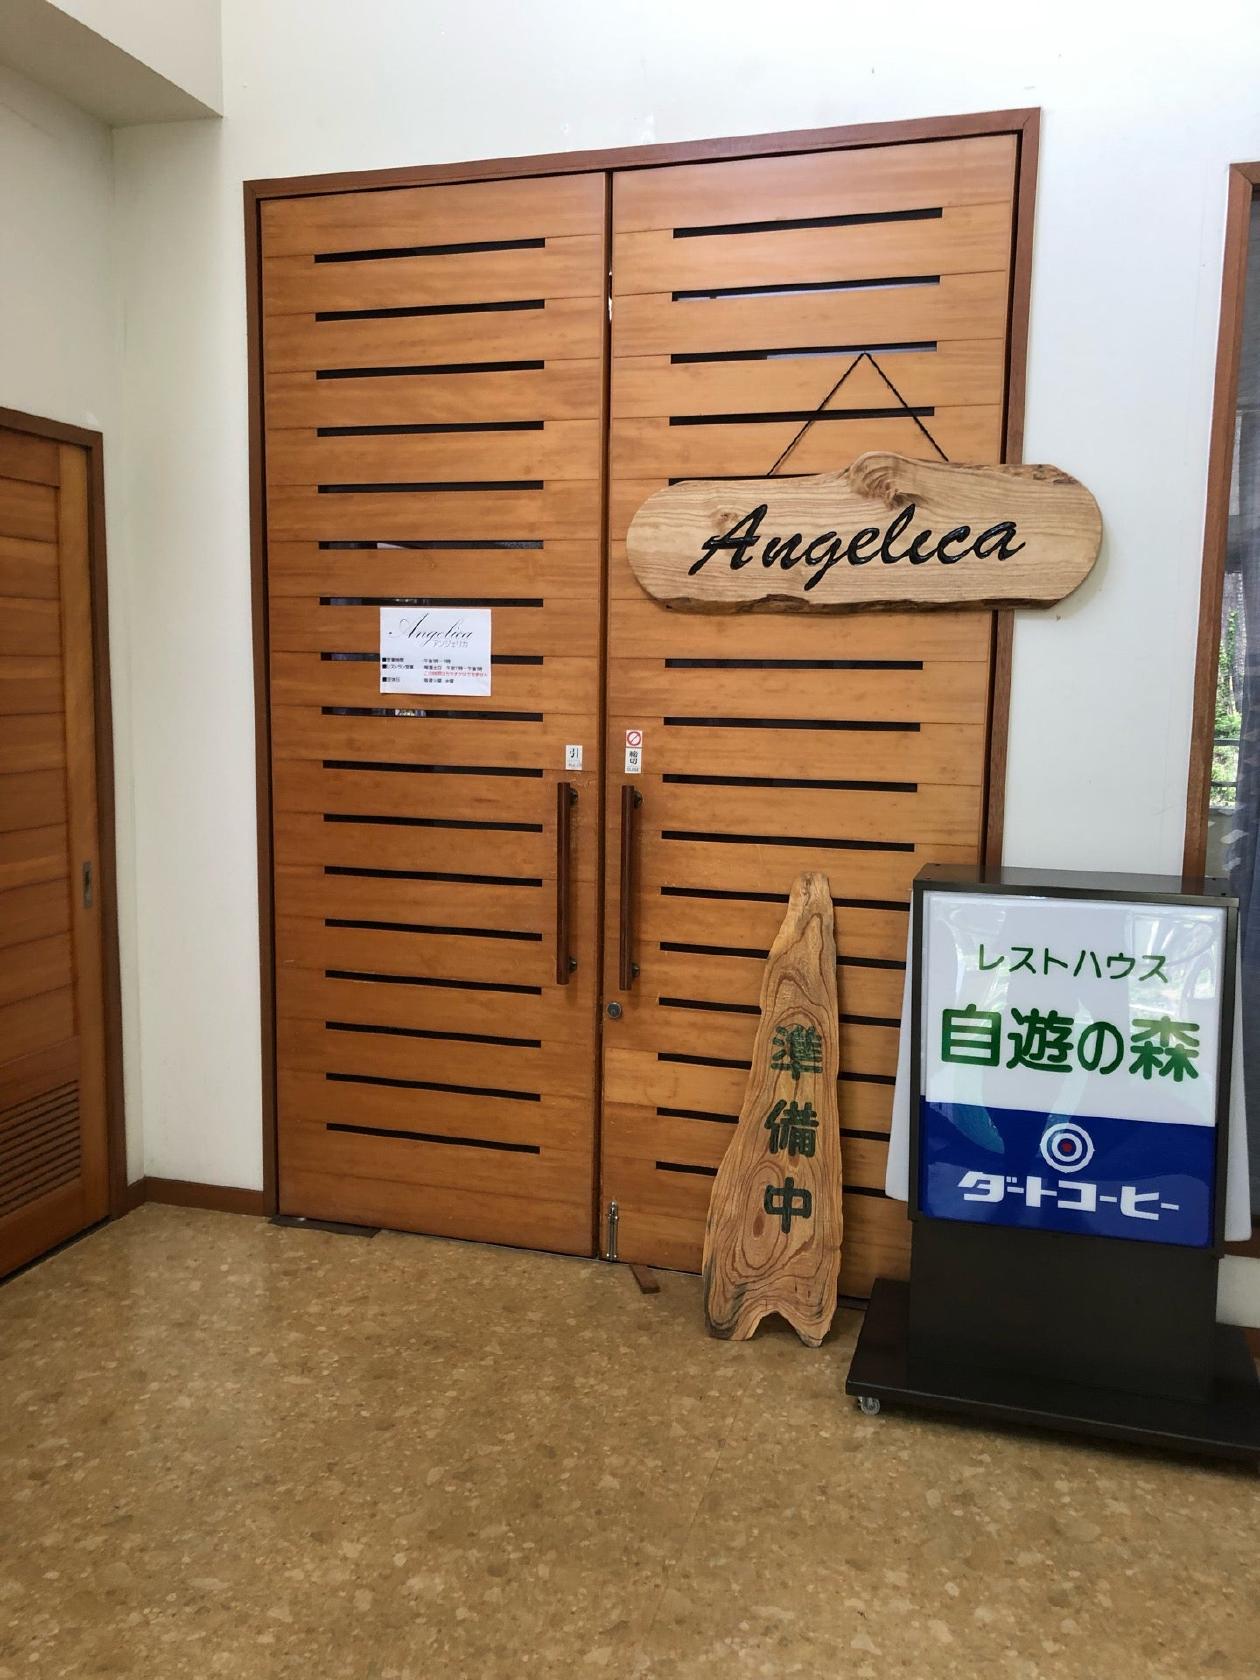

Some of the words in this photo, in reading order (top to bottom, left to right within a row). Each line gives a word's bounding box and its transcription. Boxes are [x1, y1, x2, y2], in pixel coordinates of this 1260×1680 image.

[688, 503, 1025, 591] Angelica
[978, 944, 1168, 983] レストハウス
[941, 1003, 1200, 1083] 自遊の森
[764, 1024, 823, 1234] 準備中
[957, 1170, 1180, 1221] ダートコーヒー
